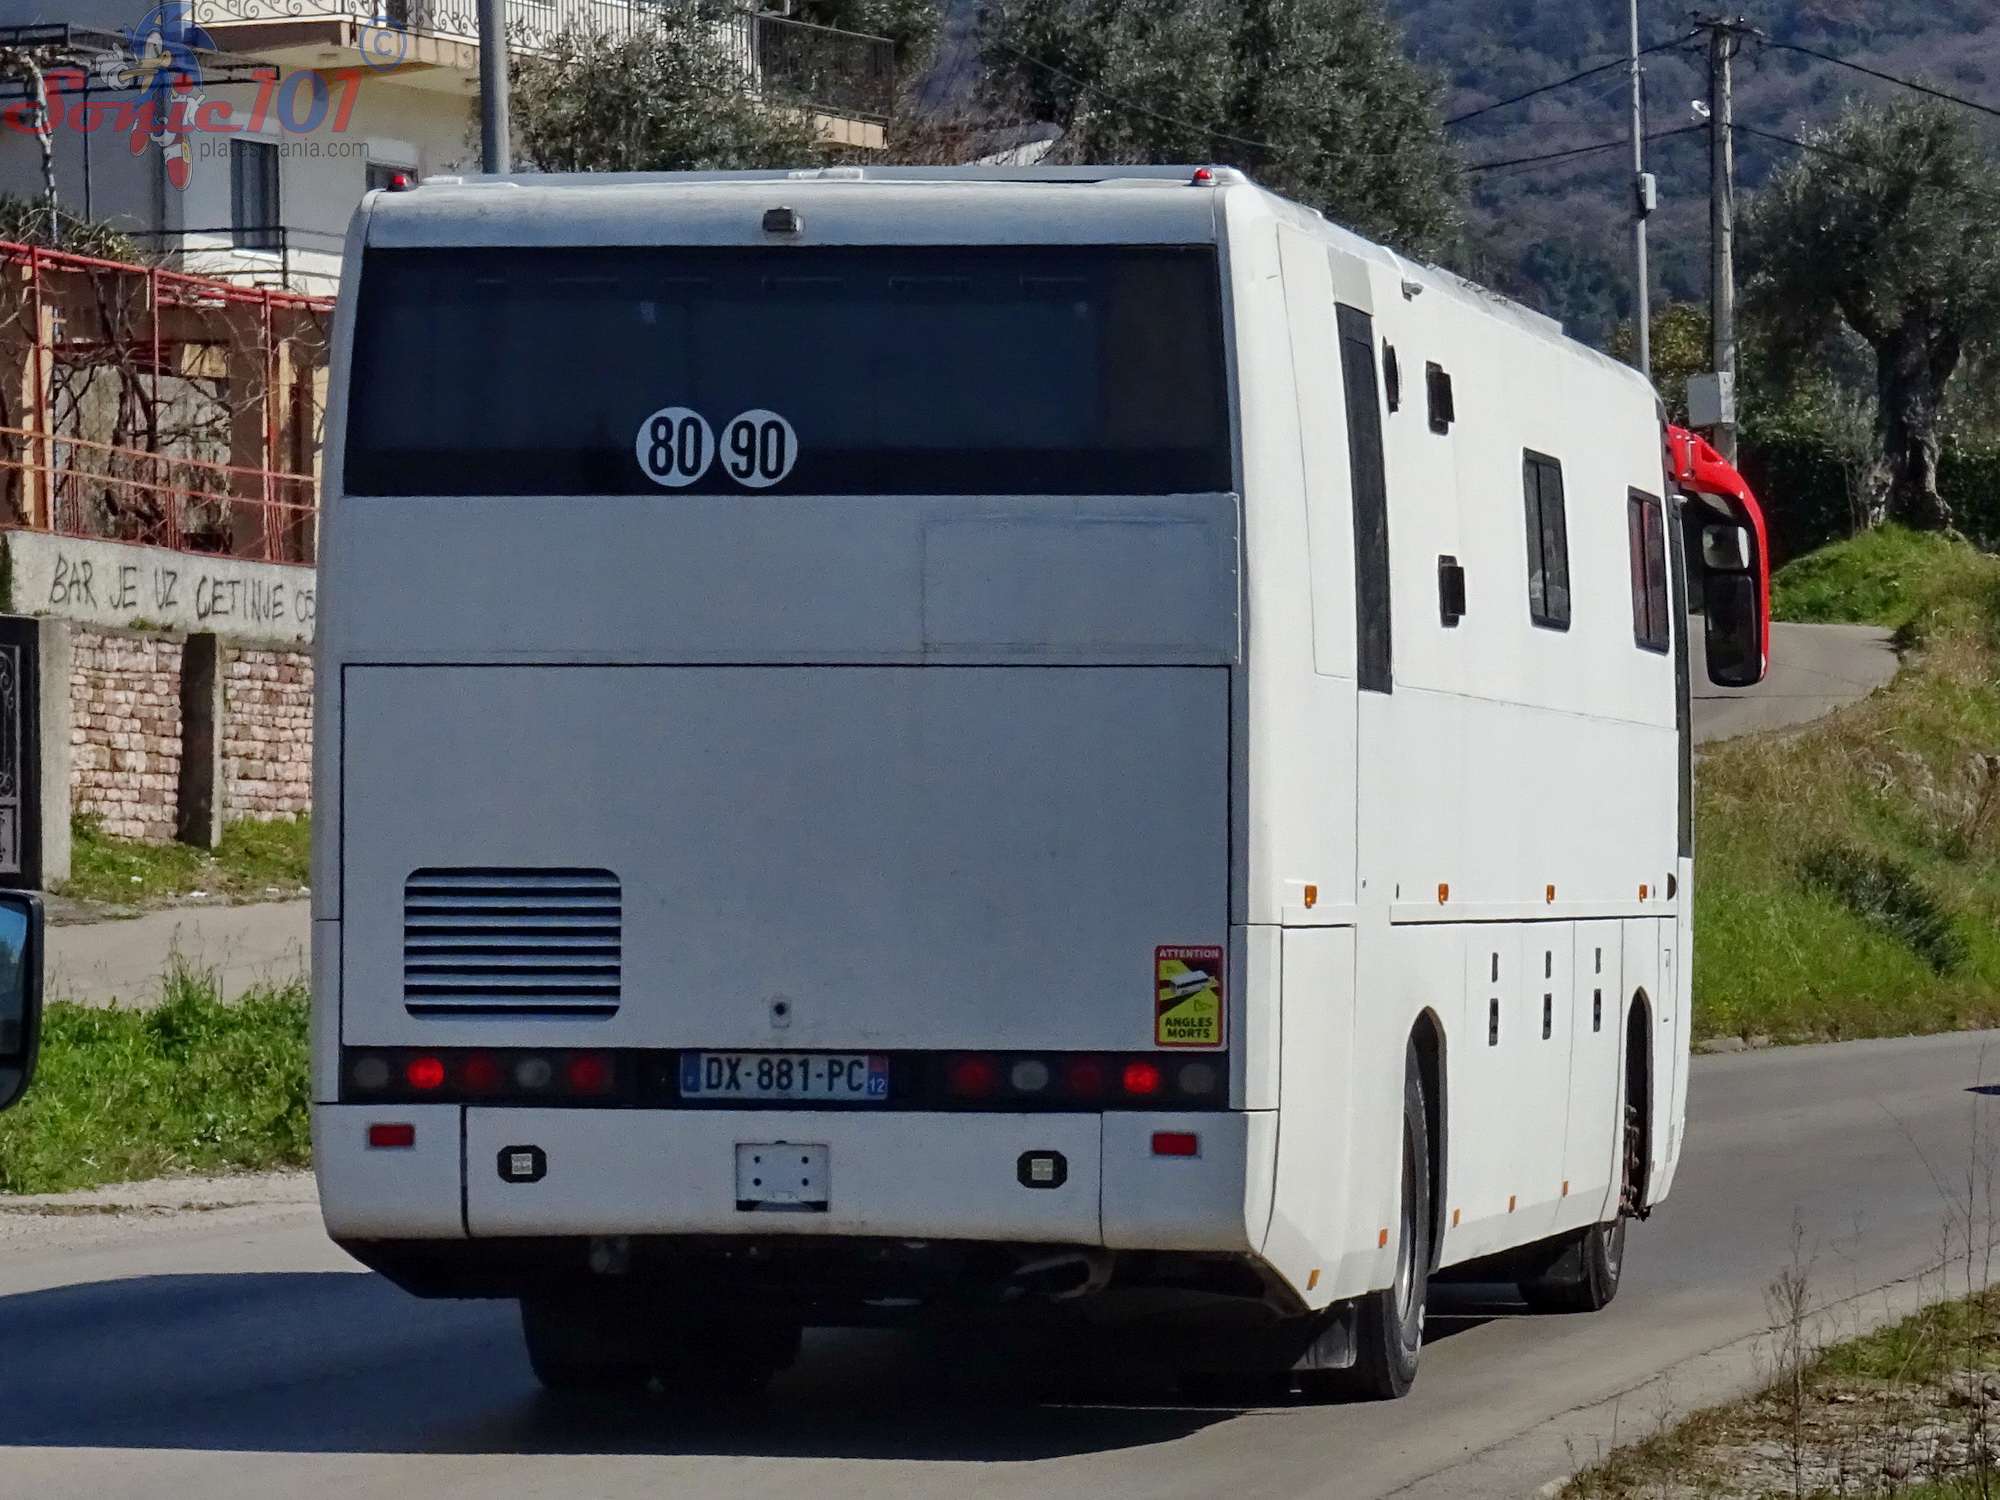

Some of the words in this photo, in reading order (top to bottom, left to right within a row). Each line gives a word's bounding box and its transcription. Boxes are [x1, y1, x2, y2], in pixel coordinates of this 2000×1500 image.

[648, 416, 703, 477] 80
[731, 419, 786, 480] 90
[49, 553, 97, 609] BAR
[109, 565, 138, 611] JE
[154, 566, 178, 610] UZ
[1160, 948, 1220, 959] ATTENTION
[1165, 1017, 1213, 1028] ANGLES
[1167, 1028, 1210, 1039] MORTS
[706, 1056, 865, 1092] DX-881-PC
[868, 1077, 886, 1094] 12
